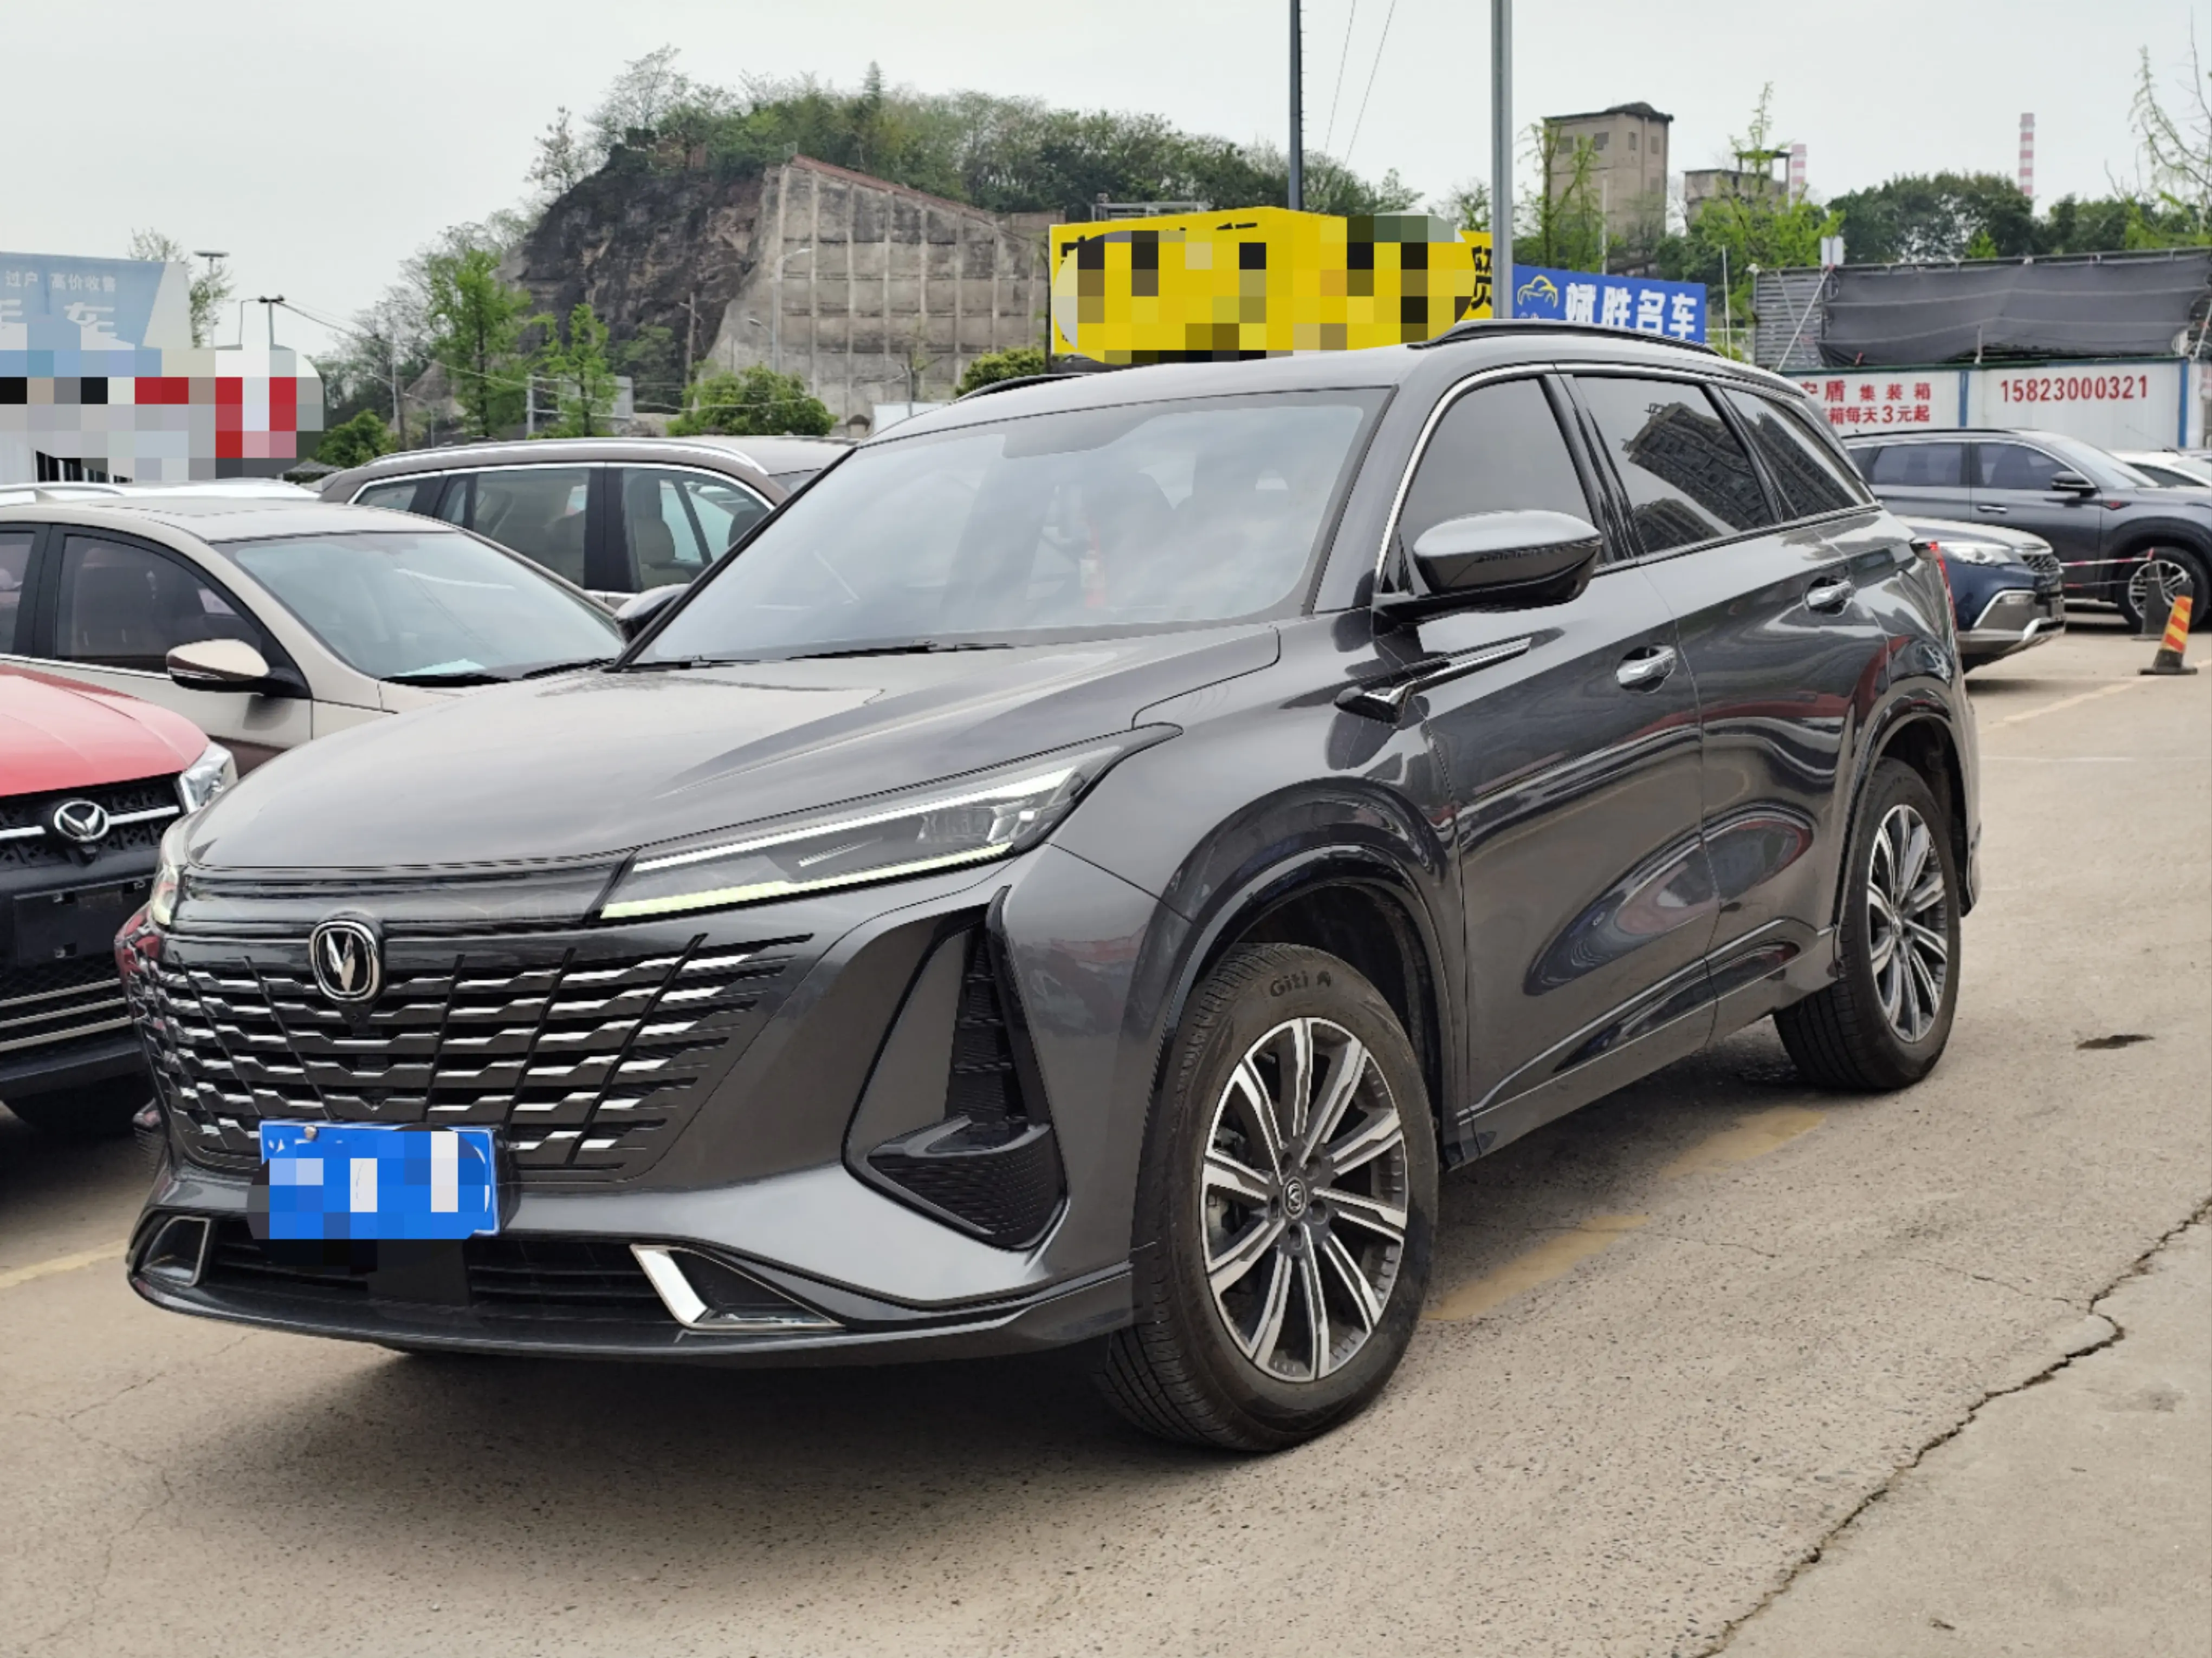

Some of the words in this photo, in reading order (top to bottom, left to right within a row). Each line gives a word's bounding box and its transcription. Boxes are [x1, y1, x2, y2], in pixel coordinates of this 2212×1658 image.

[2000, 375, 2147, 403] 15823000321
[1824, 405, 1930, 425] 箱每天3元起
